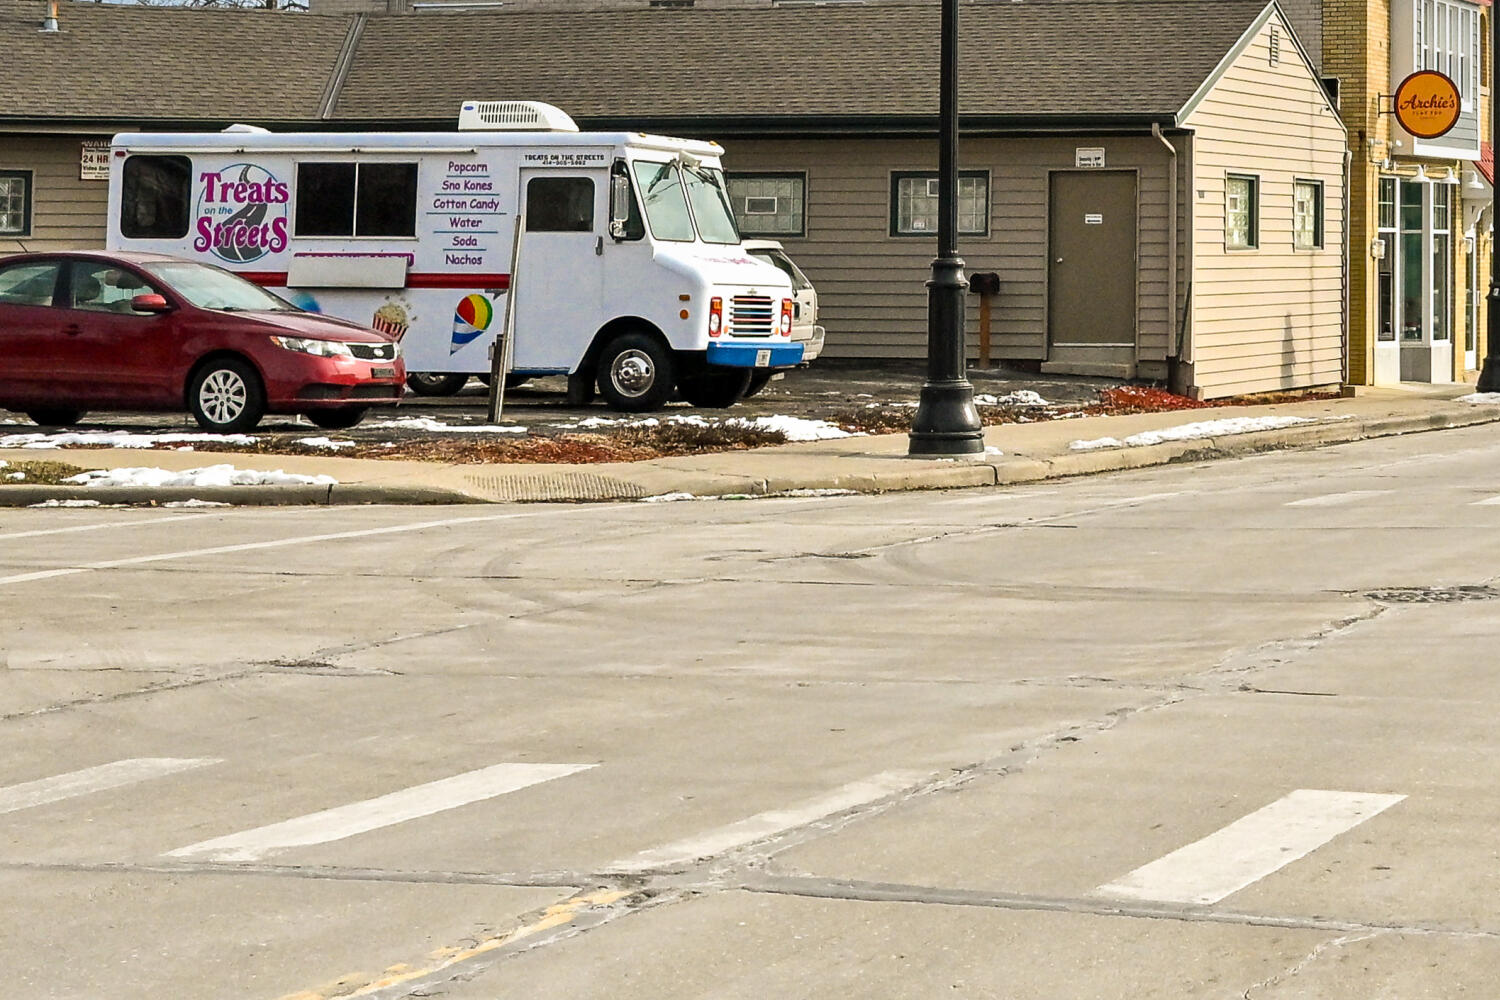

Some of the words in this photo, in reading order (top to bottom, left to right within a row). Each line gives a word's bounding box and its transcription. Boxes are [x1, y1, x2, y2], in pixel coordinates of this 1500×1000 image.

[1399, 93, 1456, 110] Archie's
[83, 154, 94, 164] 24
[448, 161, 488, 174] Popcorn
[199, 172, 290, 204] Treats
[441, 180, 461, 191] Sno
[463, 179, 493, 191] Kones
[204, 207, 216, 215] on
[218, 206, 233, 215] the
[433, 198, 467, 209] Cotton
[469, 198, 500, 212] Candy
[449, 217, 482, 228] Water
[452, 235, 478, 246] Soda
[445, 254, 483, 265] Nachos
